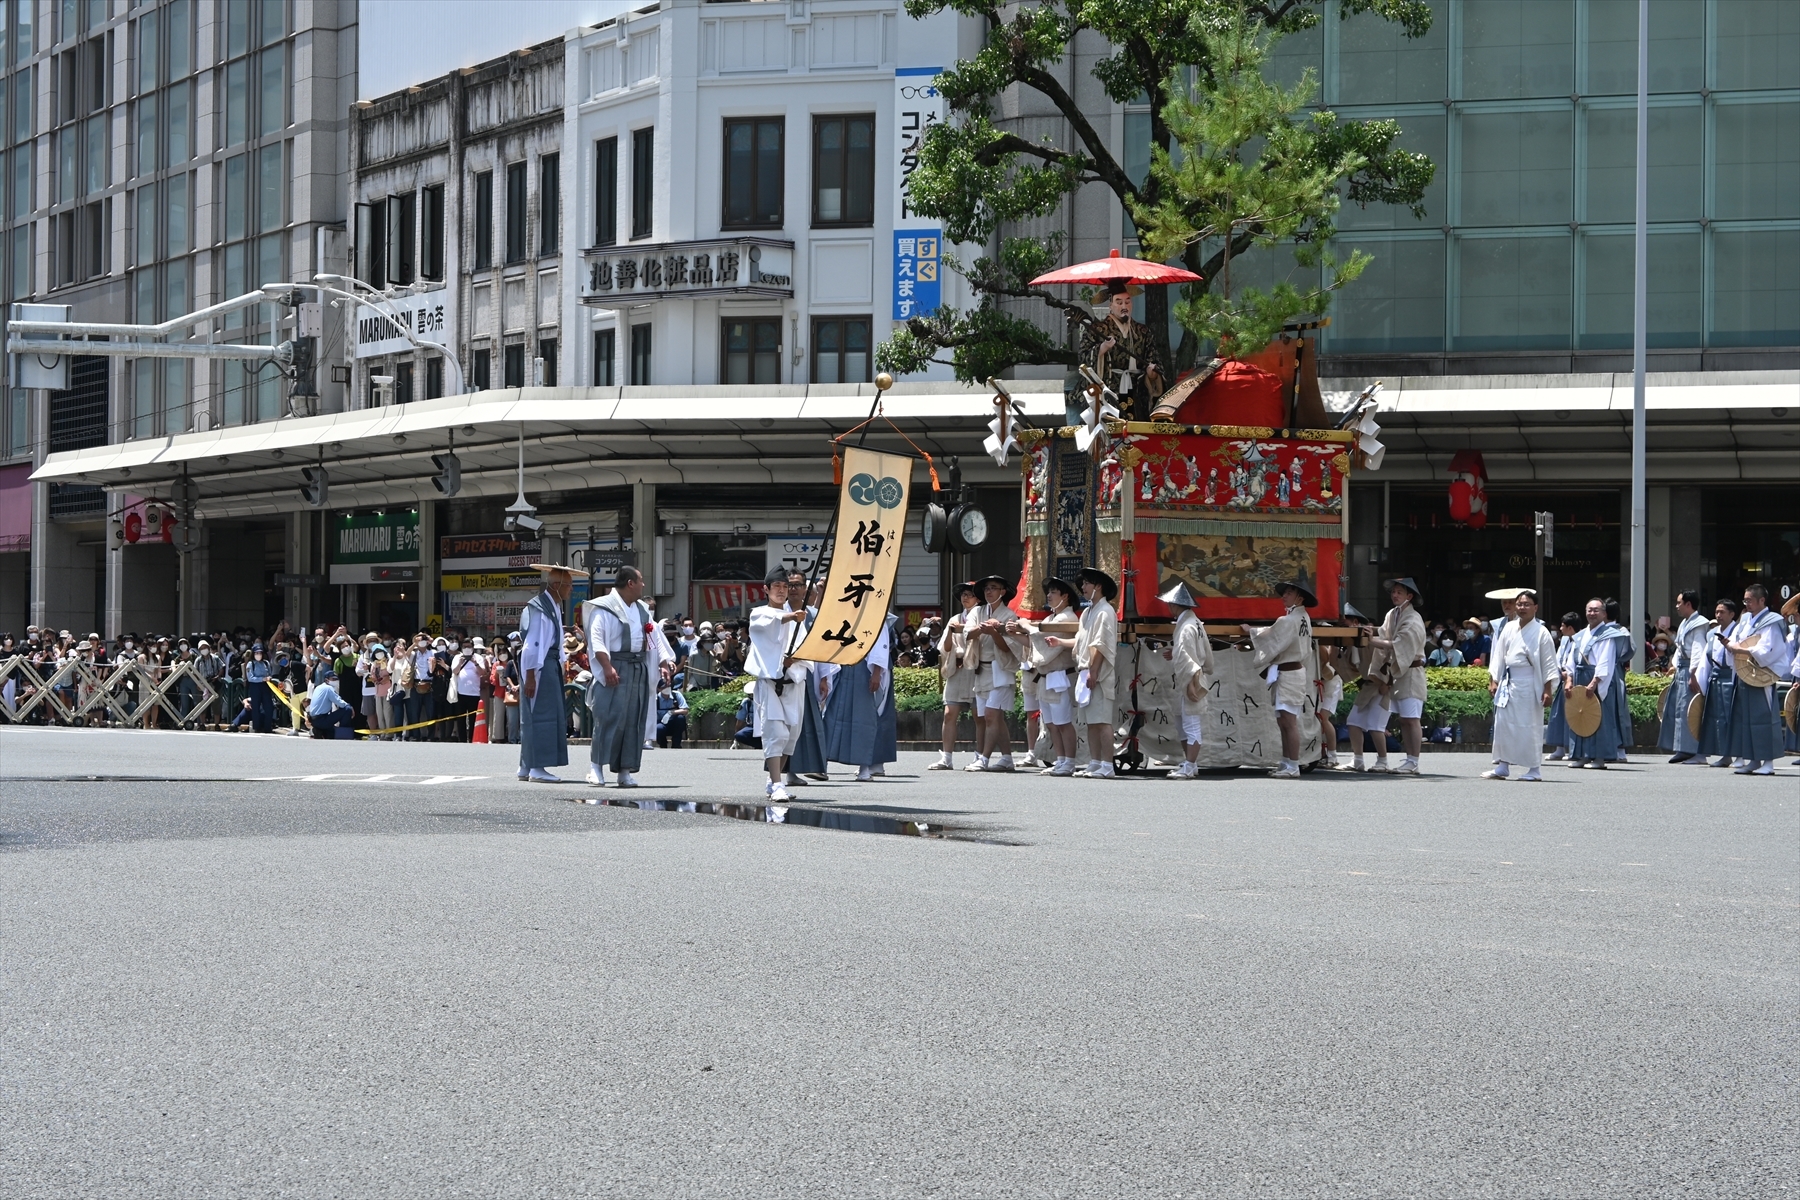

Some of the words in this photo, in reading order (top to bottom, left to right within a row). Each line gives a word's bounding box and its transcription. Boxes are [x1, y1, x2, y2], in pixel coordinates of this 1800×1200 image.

[919, 239, 935, 280] すぐ
[590, 251, 739, 292] 池善化粧品店
[897, 238, 914, 318] 買えます
[417, 304, 444, 335] 雲の茶
[340, 526, 391, 554] MARUMARU
[396, 524, 420, 551] 雲の茶
[453, 538, 520, 553] アクセスチケット
[508, 556, 526, 567] ACCESS
[595, 558, 623, 566] コンタクト
[1524, 557, 1591, 568] Taashimaya
[461, 575, 479, 588] Money
[480, 574, 508, 588] EXchange
[509, 576, 516, 586] No
[516, 575, 541, 586] Commission
[821, 519, 885, 648] 伯牙山
